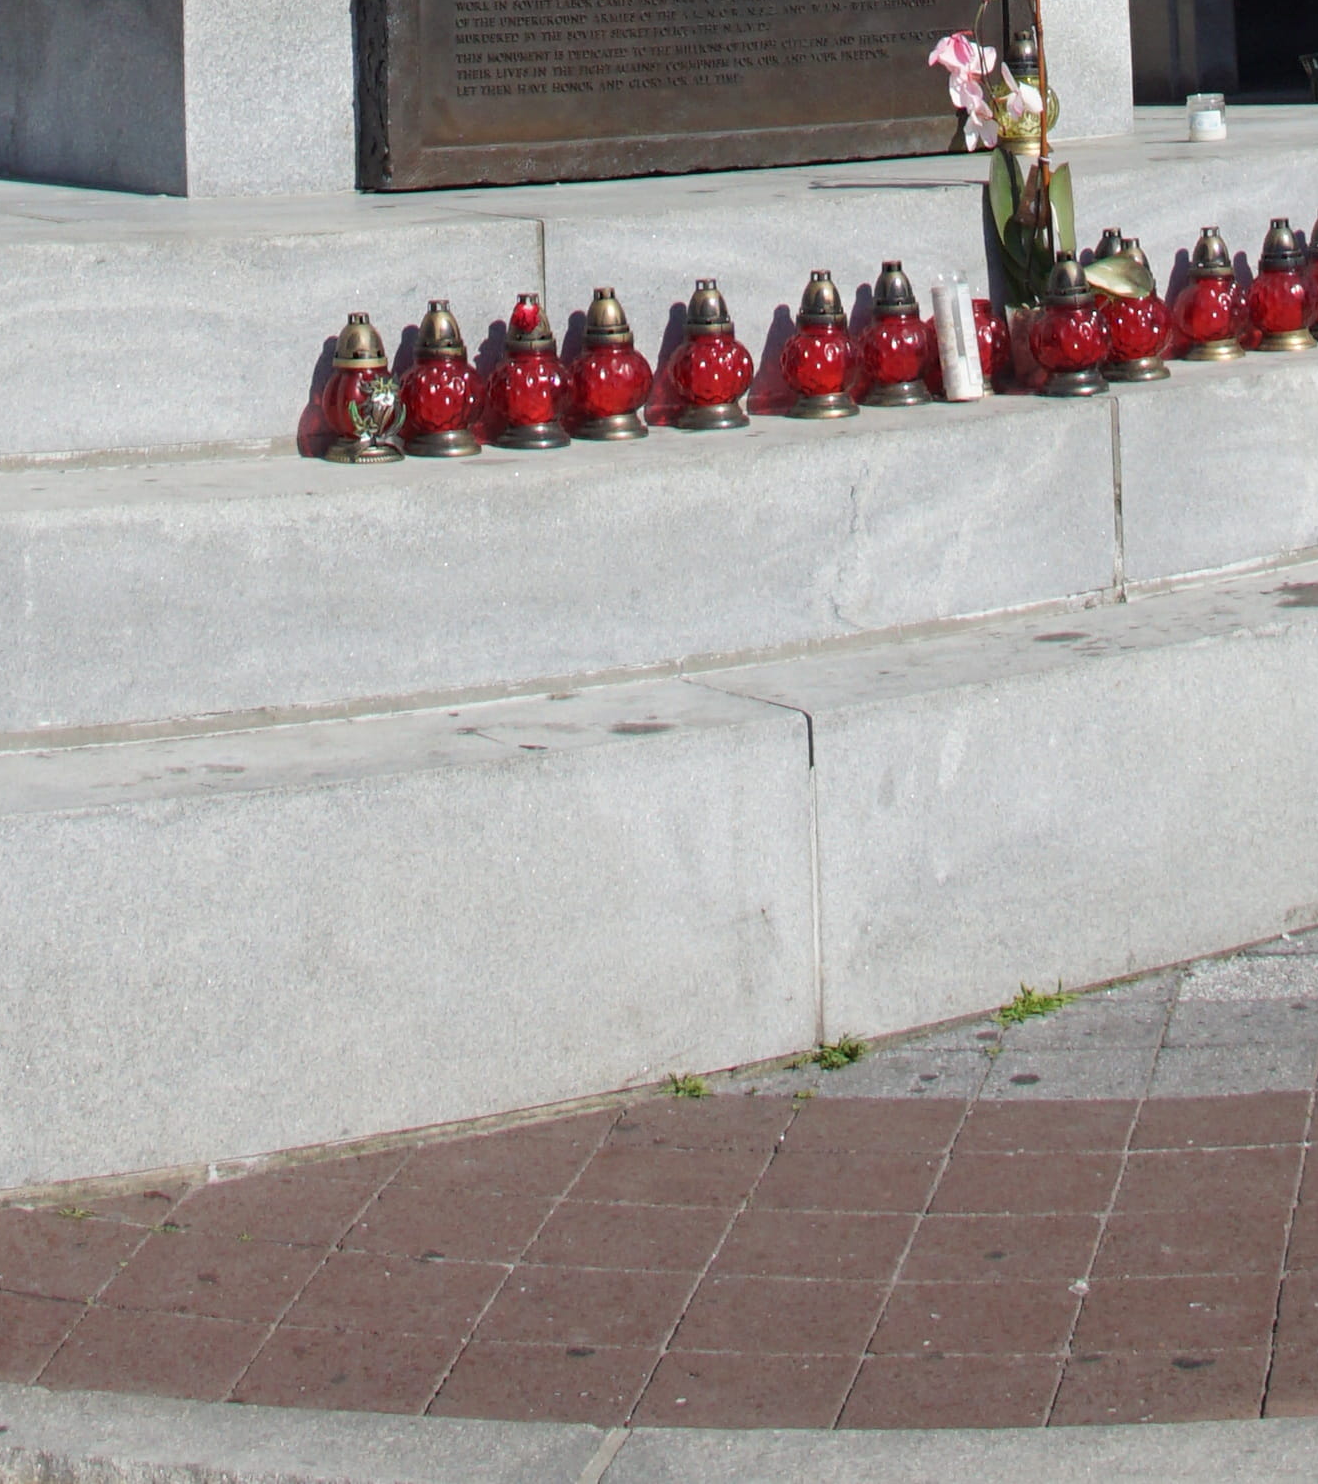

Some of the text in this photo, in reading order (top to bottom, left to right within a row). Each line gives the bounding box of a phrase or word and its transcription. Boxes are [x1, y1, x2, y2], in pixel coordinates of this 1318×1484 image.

[456, 32, 519, 43] MURDERED
[456, 53, 482, 63] THIS
[456, 69, 491, 80] THEIR
[457, 85, 477, 96] LET
